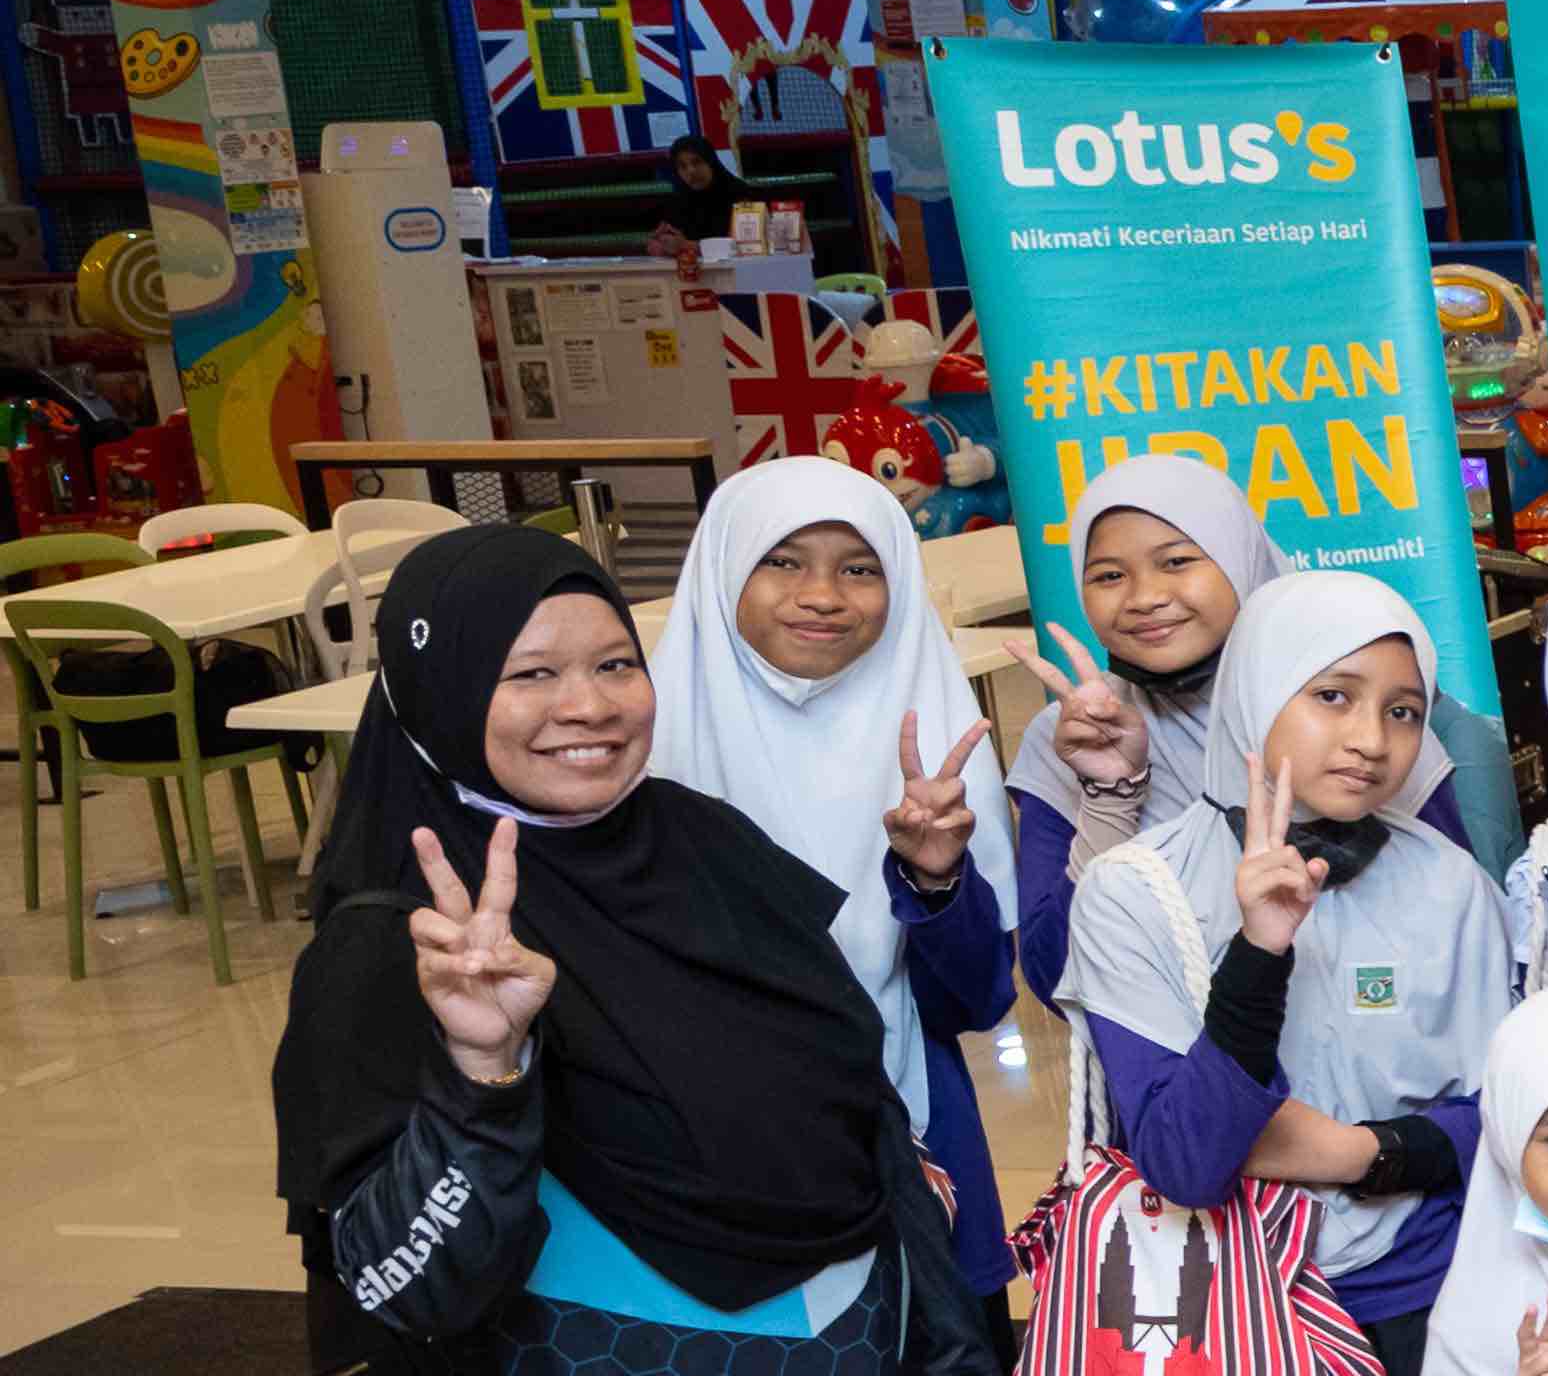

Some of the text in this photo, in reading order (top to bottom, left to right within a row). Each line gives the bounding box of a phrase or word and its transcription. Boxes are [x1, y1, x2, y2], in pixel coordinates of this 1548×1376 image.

[996, 110, 1357, 188] Lotus's
[1010, 218, 1368, 251] Nikmati Keceriaan Setiap Hari
[1023, 340, 1403, 421] #KITAKAN
[1043, 415, 1420, 546] JAN
[1317, 537, 1426, 568] komuniti
